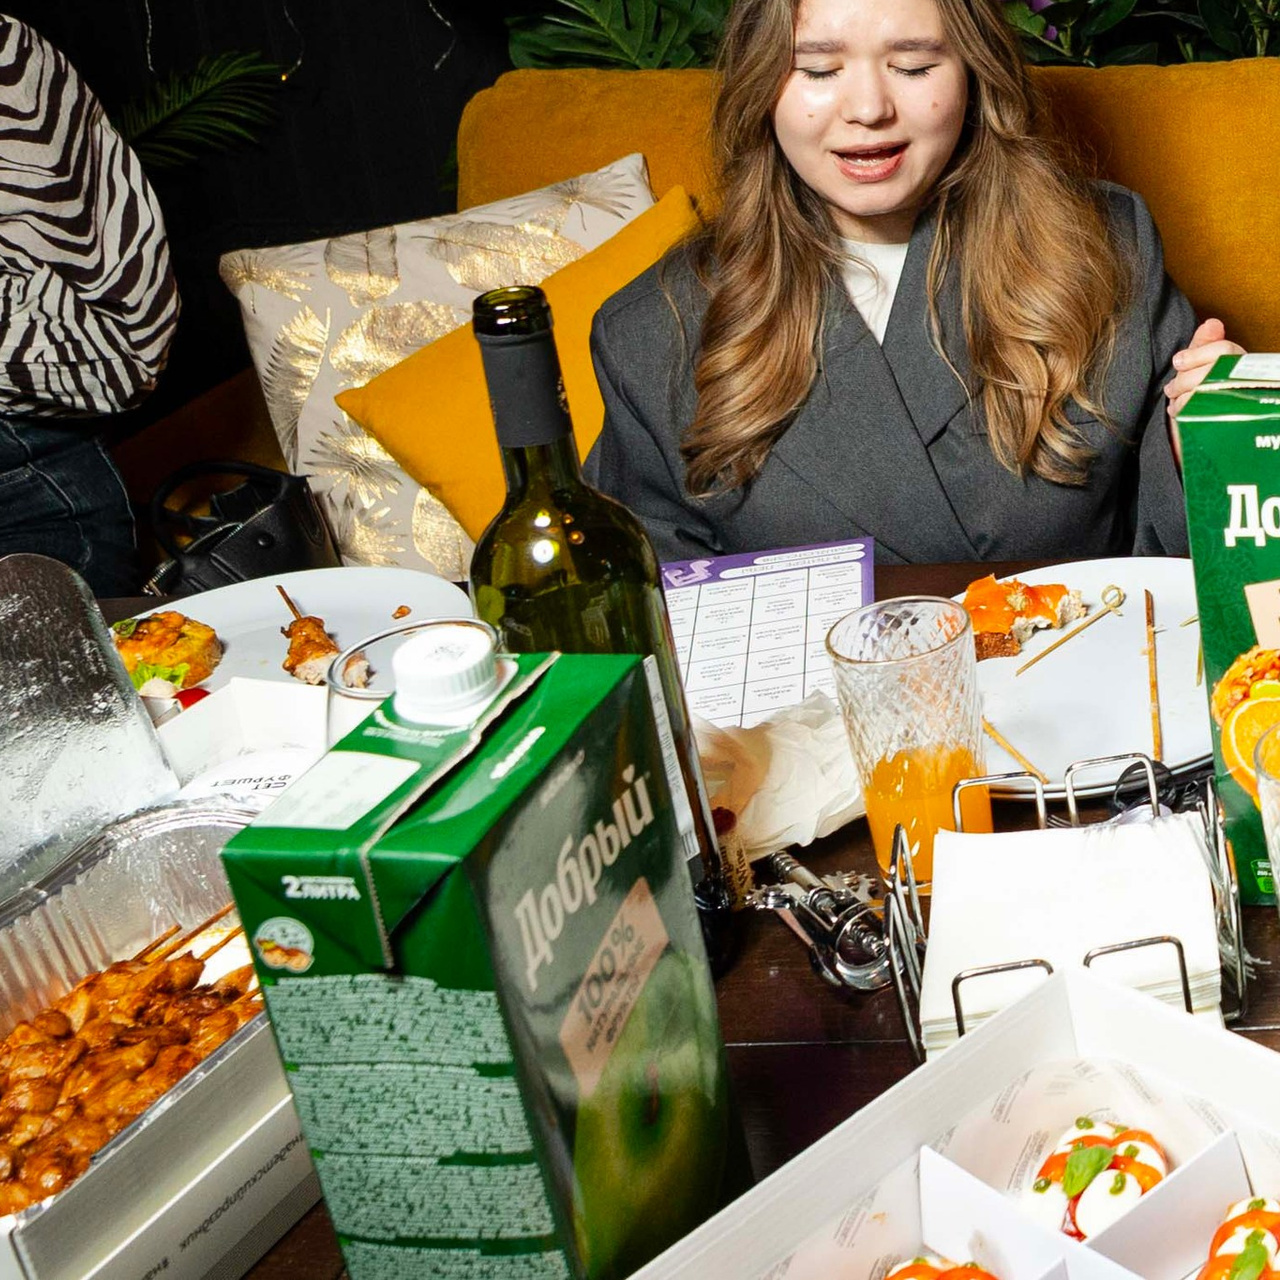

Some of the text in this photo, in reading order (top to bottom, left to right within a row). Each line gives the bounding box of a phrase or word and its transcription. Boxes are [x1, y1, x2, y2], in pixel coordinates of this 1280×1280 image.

[211, 774, 292, 789] ФУРШЕТ
[281, 874, 301, 899] 2
[301, 883, 362, 901] ЛИТРА
[514, 763, 655, 990] Добрый
